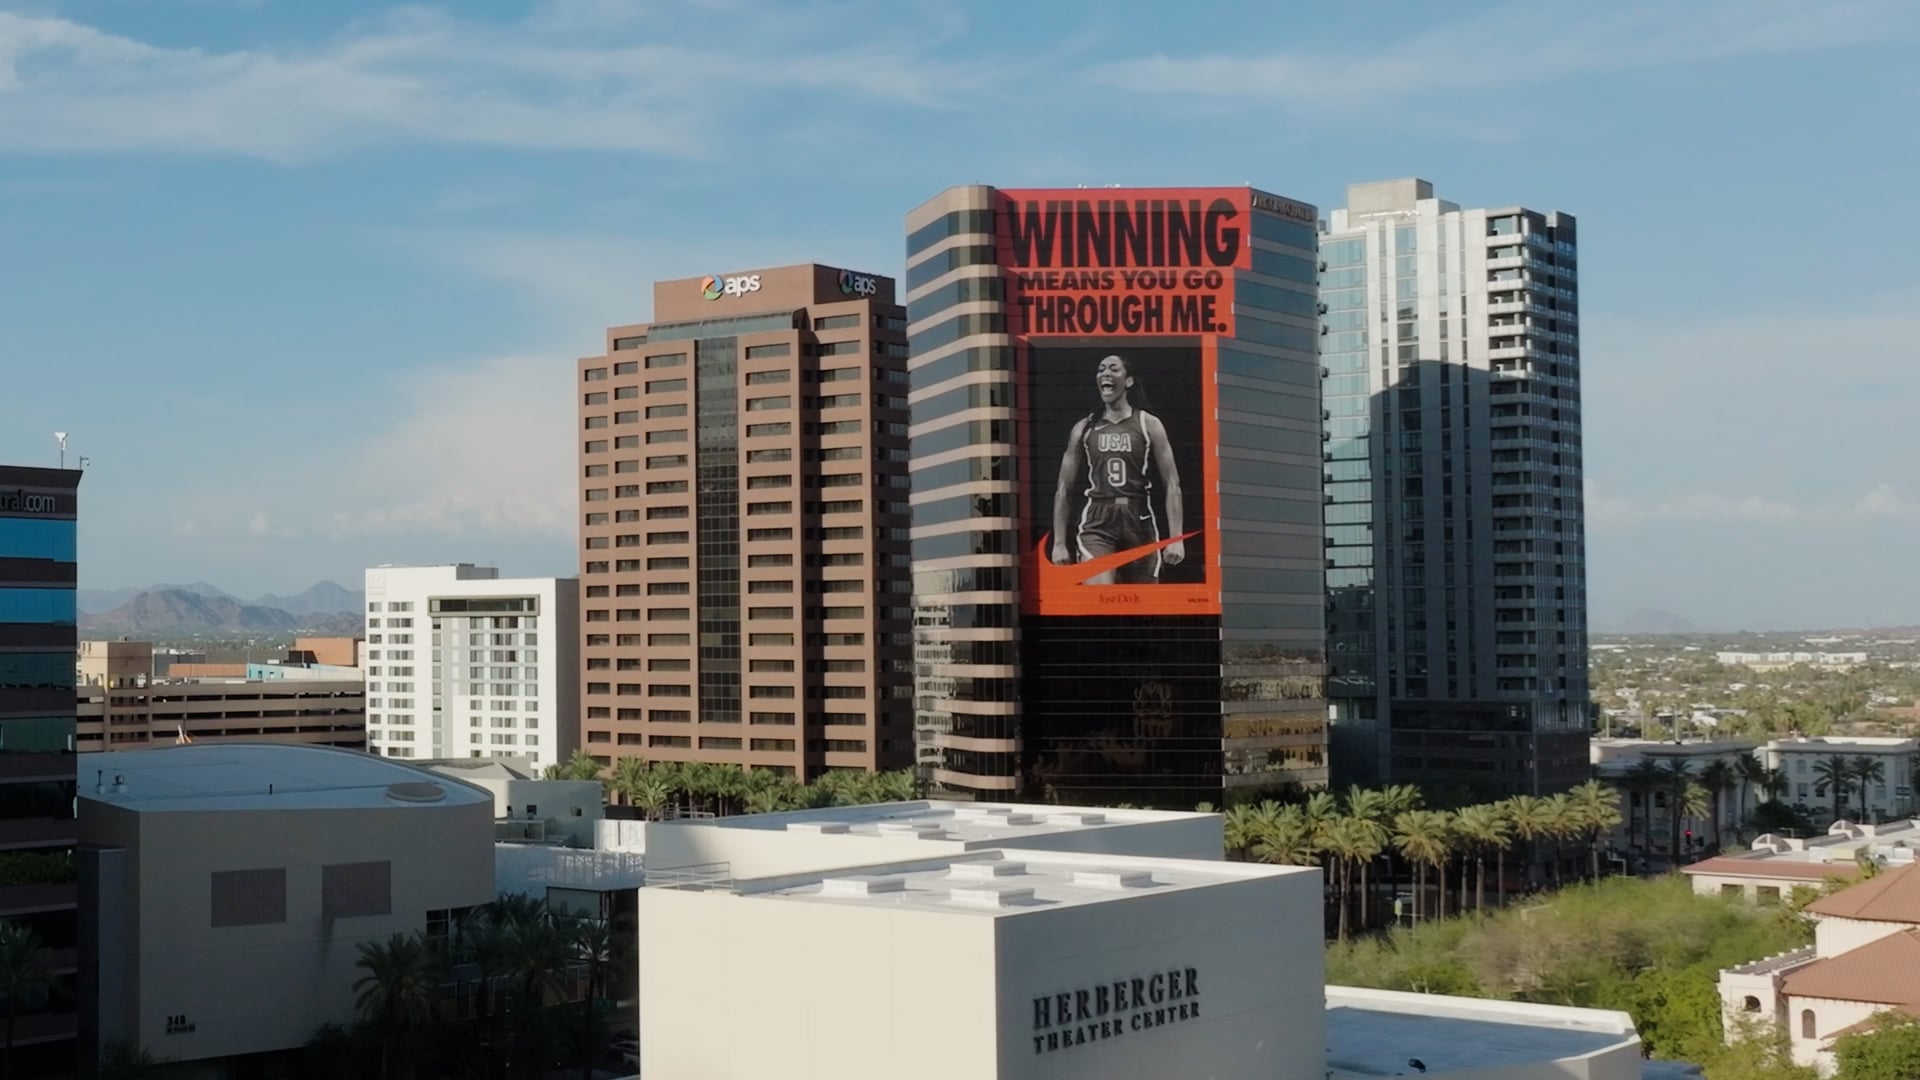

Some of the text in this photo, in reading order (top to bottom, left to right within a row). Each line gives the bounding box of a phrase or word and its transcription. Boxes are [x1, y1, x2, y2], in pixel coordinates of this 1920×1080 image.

[1006, 198, 1240, 268] WINNING
[725, 274, 761, 297] aps
[853, 275, 877, 296] aps
[1017, 269, 1223, 291] MEANS YOU GO
[1017, 295, 1227, 333] THROUGH ME.
[1098, 433, 1132, 452] USA
[1107, 457, 1127, 487] 9
[1033, 967, 1200, 1031] HERBERGER
[1033, 1001, 1200, 1055] THEATER CENTER
